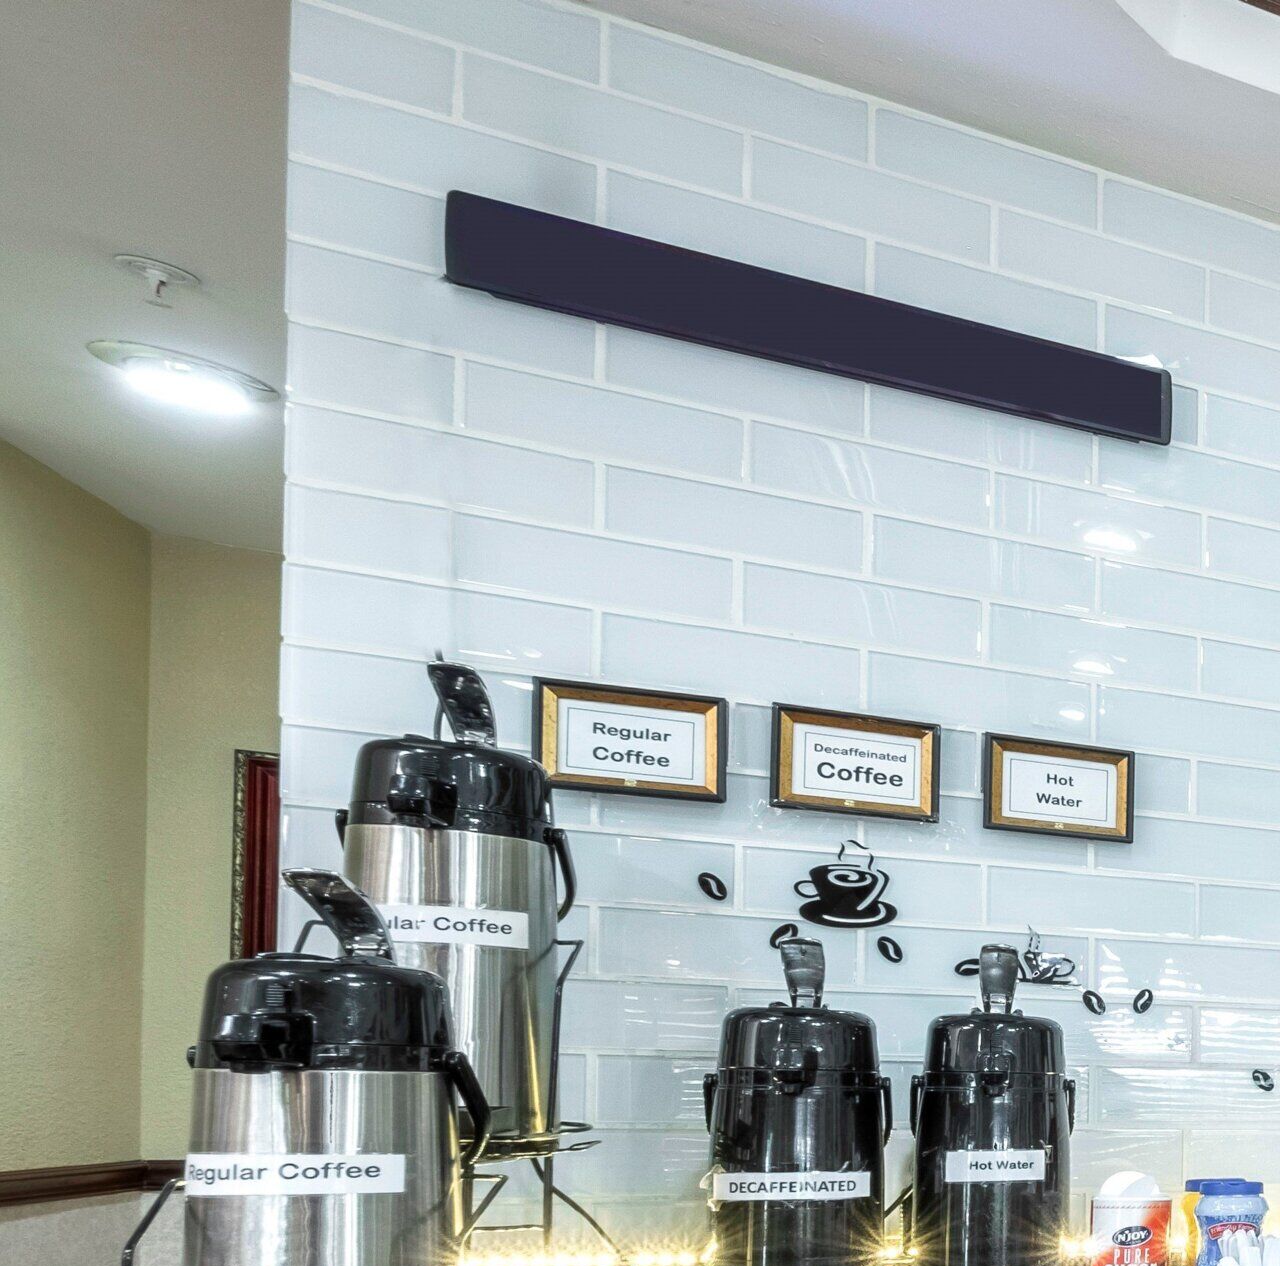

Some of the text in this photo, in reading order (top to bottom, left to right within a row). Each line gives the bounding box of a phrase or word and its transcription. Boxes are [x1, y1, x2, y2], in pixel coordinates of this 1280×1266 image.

[592, 722, 672, 742] Regular
[592, 746, 670, 768] Coffee
[814, 743, 907, 763] Decaffeinated
[817, 762, 904, 787] Coffee
[1046, 773, 1074, 787] Hot
[1036, 792, 1083, 808] Water
[433, 916, 513, 935] Coffee
[188, 1162, 381, 1185] Regular Coffee
[969, 1159, 1035, 1171] Hot Water
[728, 1180, 857, 1194] DECAFFEINATED
[1113, 1247, 1150, 1264] PURE
